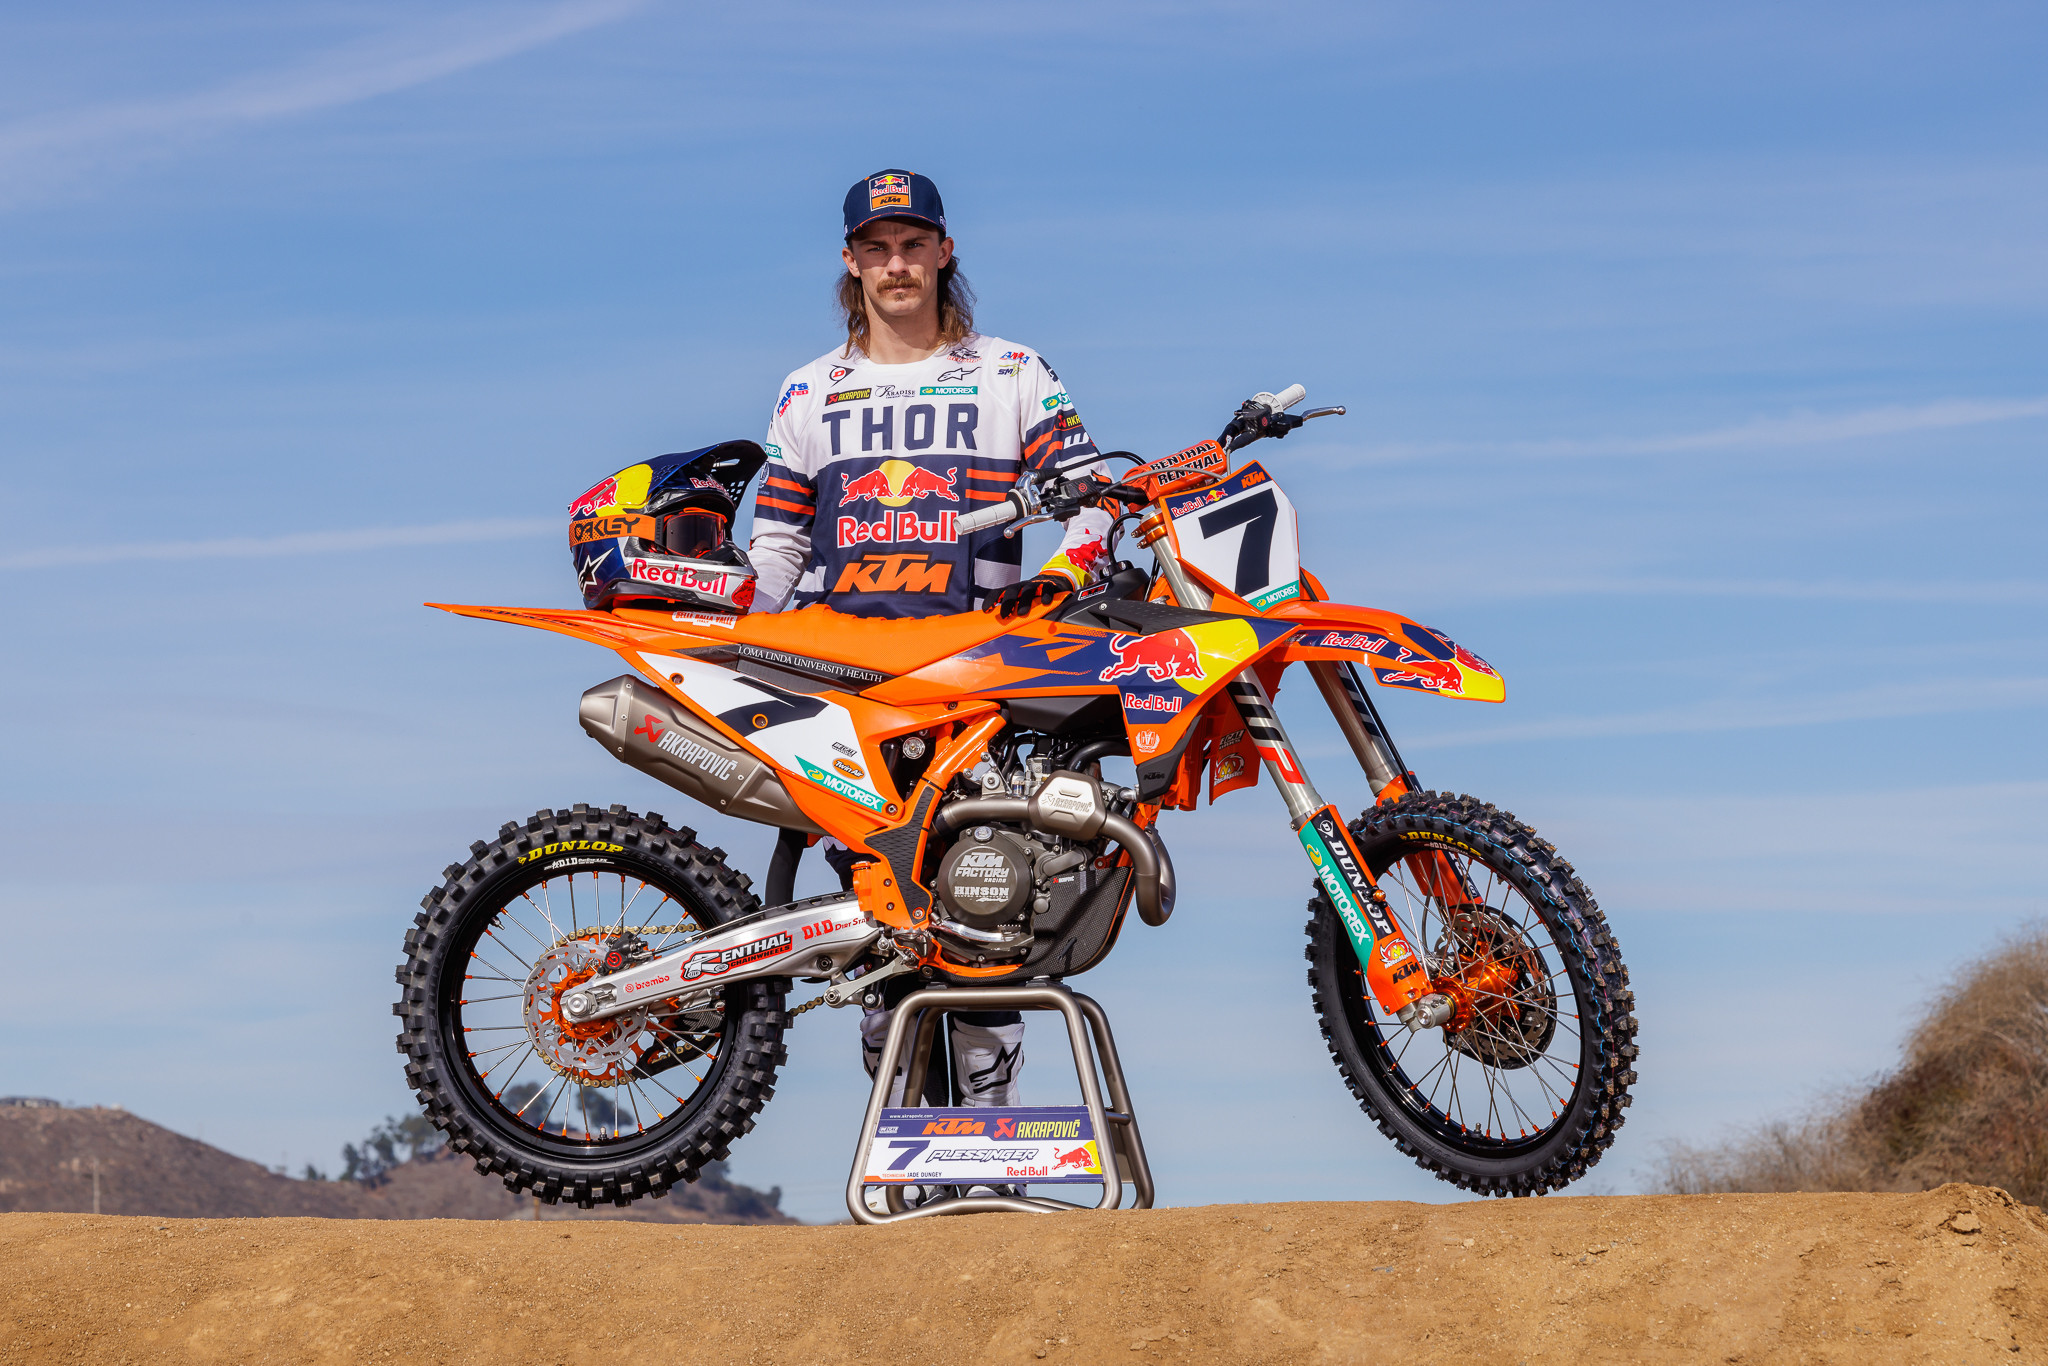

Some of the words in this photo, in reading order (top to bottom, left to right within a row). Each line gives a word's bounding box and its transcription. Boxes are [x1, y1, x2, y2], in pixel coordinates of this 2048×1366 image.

[872, 186, 889, 197] Red
[890, 185, 908, 195] Bull
[880, 196, 901, 204] KTM
[935, 387, 974, 395] MOTOREX
[822, 403, 979, 456] THOR
[1149, 443, 1216, 470] RENTHAL
[1157, 452, 1223, 486] RENTHAL
[1241, 471, 1266, 489] KTM
[1171, 503, 1190, 518] Red
[1187, 496, 1205, 512] Bull
[574, 517, 641, 541] OAKLEY
[837, 510, 894, 548] Red
[896, 510, 959, 544] Bull
[1198, 488, 1278, 597] 7
[632, 558, 679, 585] Red
[832, 553, 953, 593] KTM
[1265, 584, 1298, 603] MOTOREX
[1320, 632, 1359, 648] Red
[1349, 634, 1389, 653] Bull
[738, 646, 764, 659] LOMA
[765, 651, 792, 664] LINDA
[794, 658, 845, 675] UNIVERSITY
[846, 670, 882, 682] HEALTH
[715, 676, 829, 738] 7
[1125, 693, 1153, 710] Red
[1153, 695, 1182, 713] Bull
[657, 730, 739, 781] AKRAPOVIČ
[835, 760, 852, 773] Twin
[823, 775, 881, 809] MOTOREX
[528, 840, 624, 862] DUNLOP
[1407, 831, 1482, 857] DUNLOP
[960, 852, 1004, 867] KTM
[955, 867, 1010, 877] FACTORY
[954, 886, 1009, 896] HINSON
[1329, 840, 1392, 934] DUNLOP
[1318, 864, 1370, 945] MOTOREX
[730, 945, 790, 967] CHAINWHEELS
[635, 975, 670, 990] brembo
[1392, 961, 1420, 984] KTM
[922, 1118, 985, 1135] KTM
[1017, 1119, 1080, 1138] AKRAPOVIČ
[887, 1140, 930, 1170] 7
[925, 1149, 1039, 1163] PLESSINGER
[1007, 1166, 1027, 1176] Red
[1029, 1166, 1048, 1176] Bull
